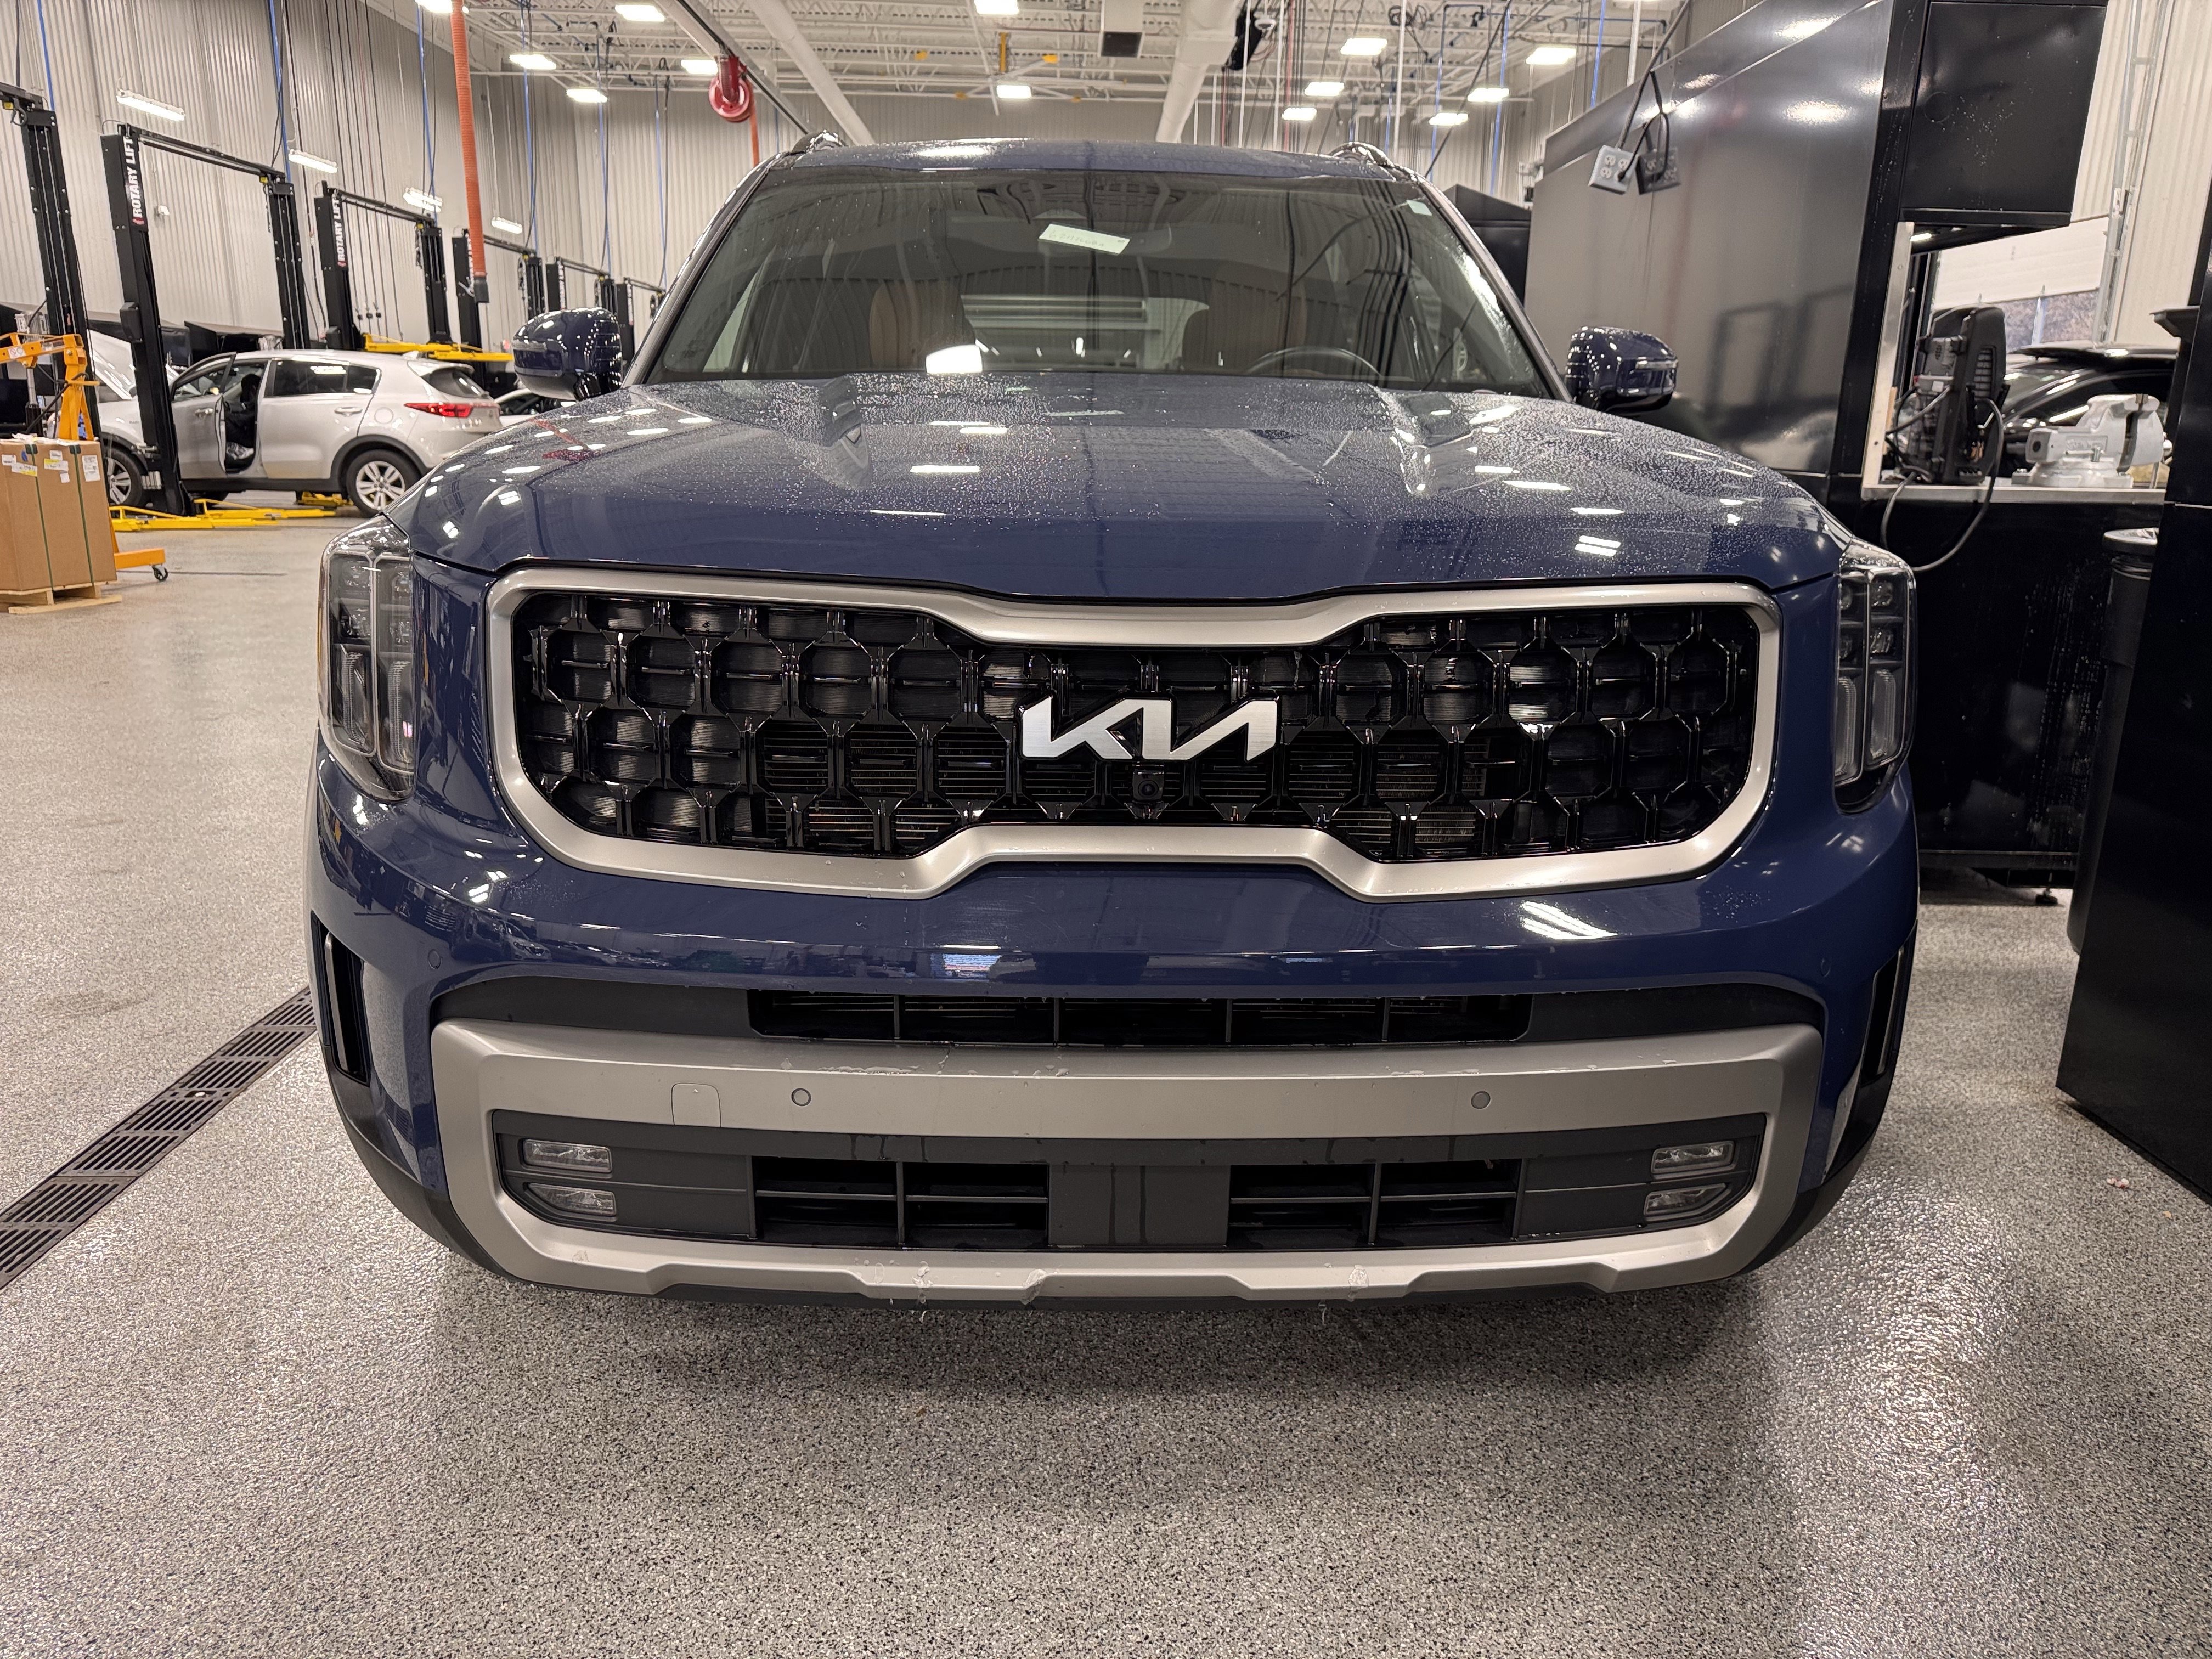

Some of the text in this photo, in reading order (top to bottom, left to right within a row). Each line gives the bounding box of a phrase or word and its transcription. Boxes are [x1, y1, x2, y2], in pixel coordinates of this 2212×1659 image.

[123, 136, 143, 218] ROTARY LIFT
[331, 197, 345, 261] ROTARY LIFT
[1023, 697, 1277, 761] KIA
